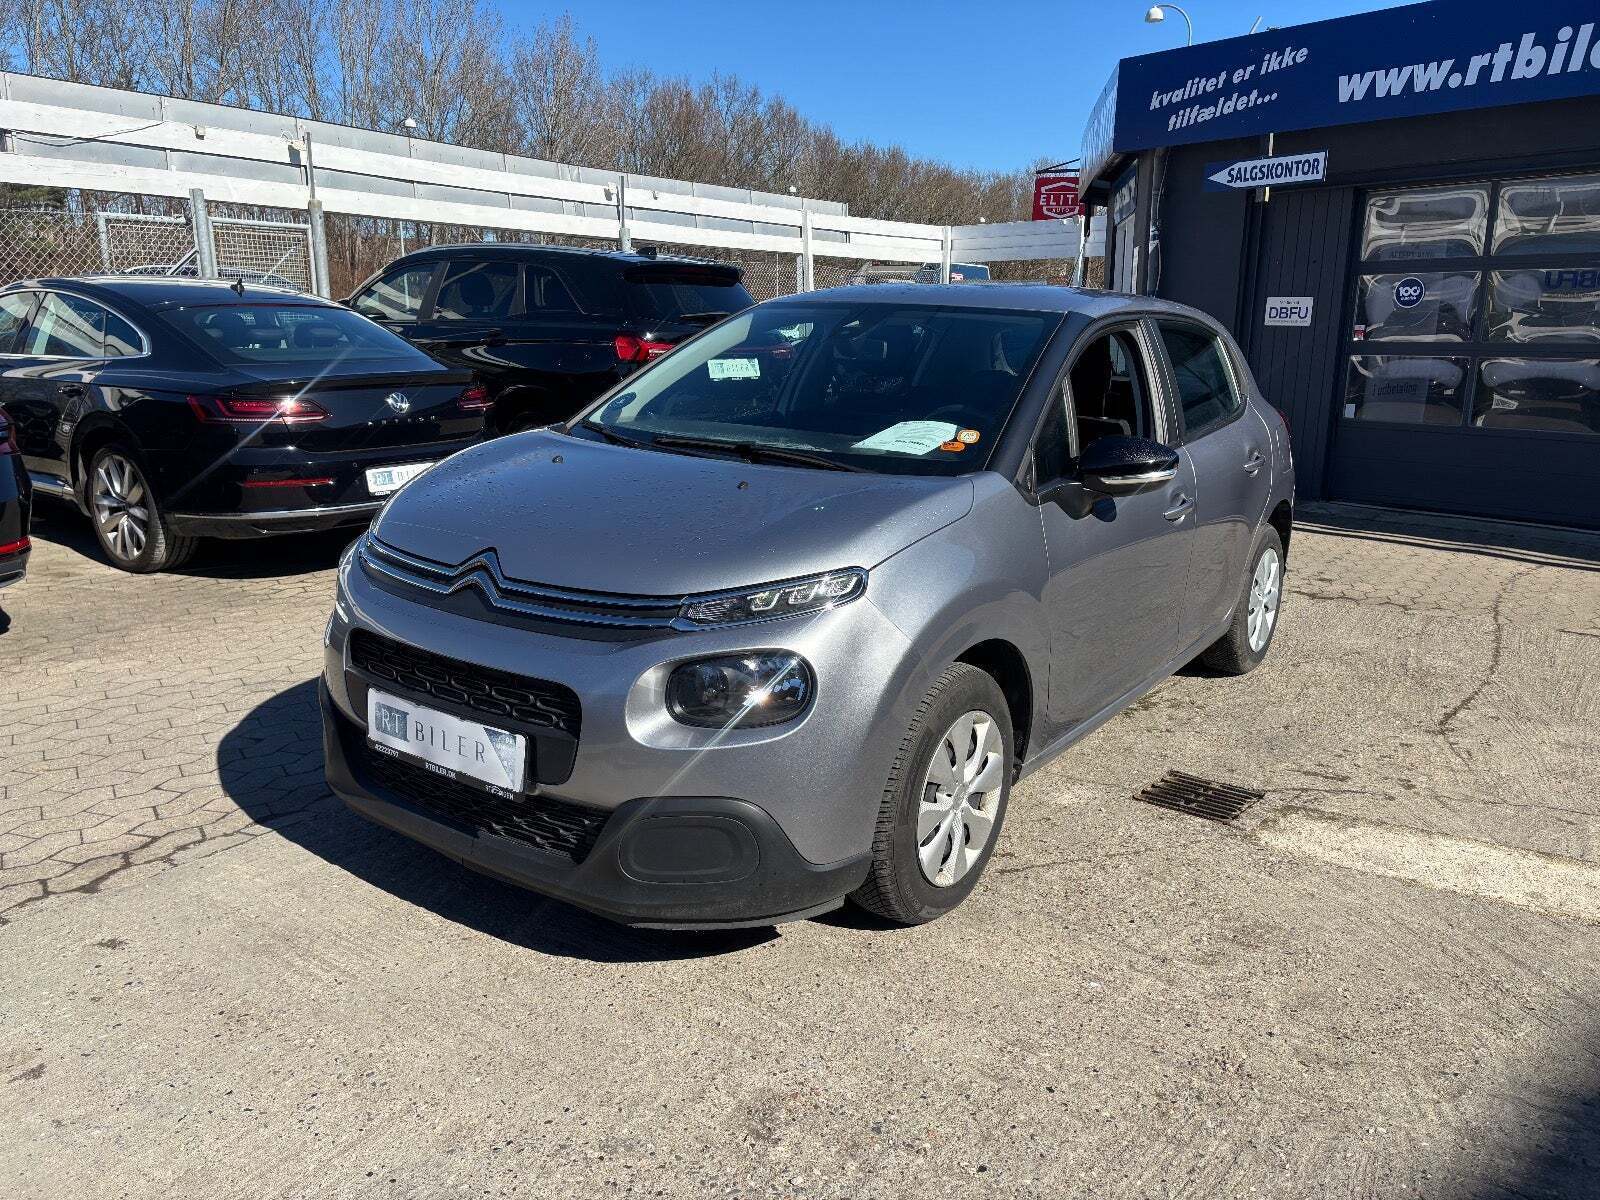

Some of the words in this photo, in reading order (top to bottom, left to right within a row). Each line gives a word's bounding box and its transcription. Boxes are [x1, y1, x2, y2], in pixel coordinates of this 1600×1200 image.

[1149, 70, 1227, 111] kvalitet
[1232, 64, 1256, 84] er
[1259, 46, 1309, 76] ikke
[1167, 89, 1278, 132] tilfældet...
[1226, 157, 1320, 184] SALGSKONTOR
[1039, 194, 1079, 206] ELIT
[1268, 306, 1309, 319] DBFU
[381, 709, 401, 734] RT
[415, 720, 486, 764] BILER
